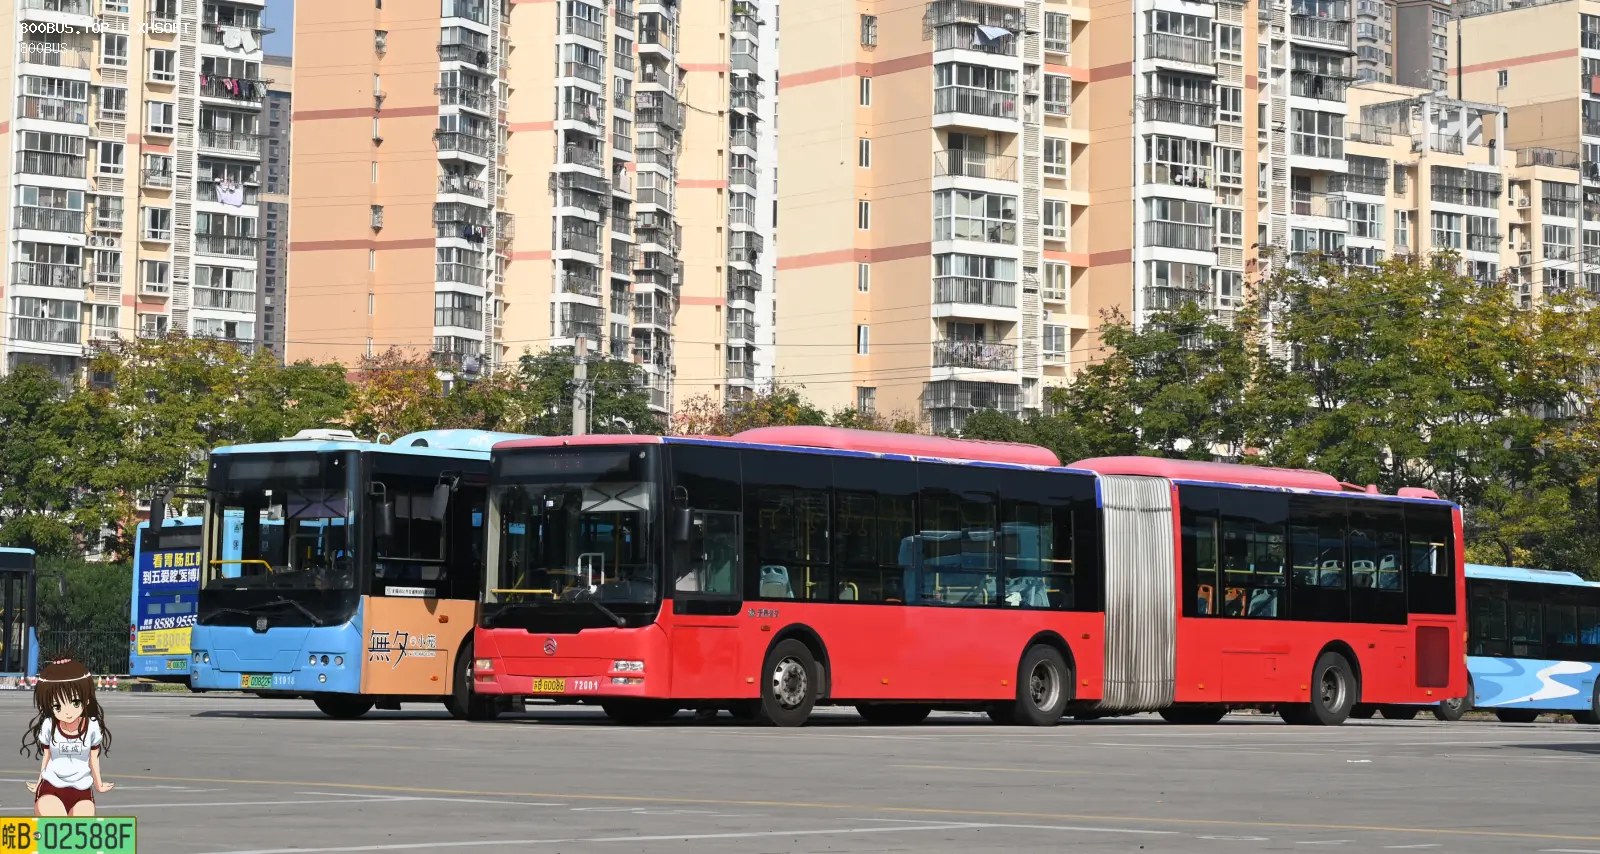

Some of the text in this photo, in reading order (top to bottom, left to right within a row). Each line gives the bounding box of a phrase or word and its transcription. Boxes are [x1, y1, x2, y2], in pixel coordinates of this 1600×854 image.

[142, 568, 200, 584] 到五爱路医博
